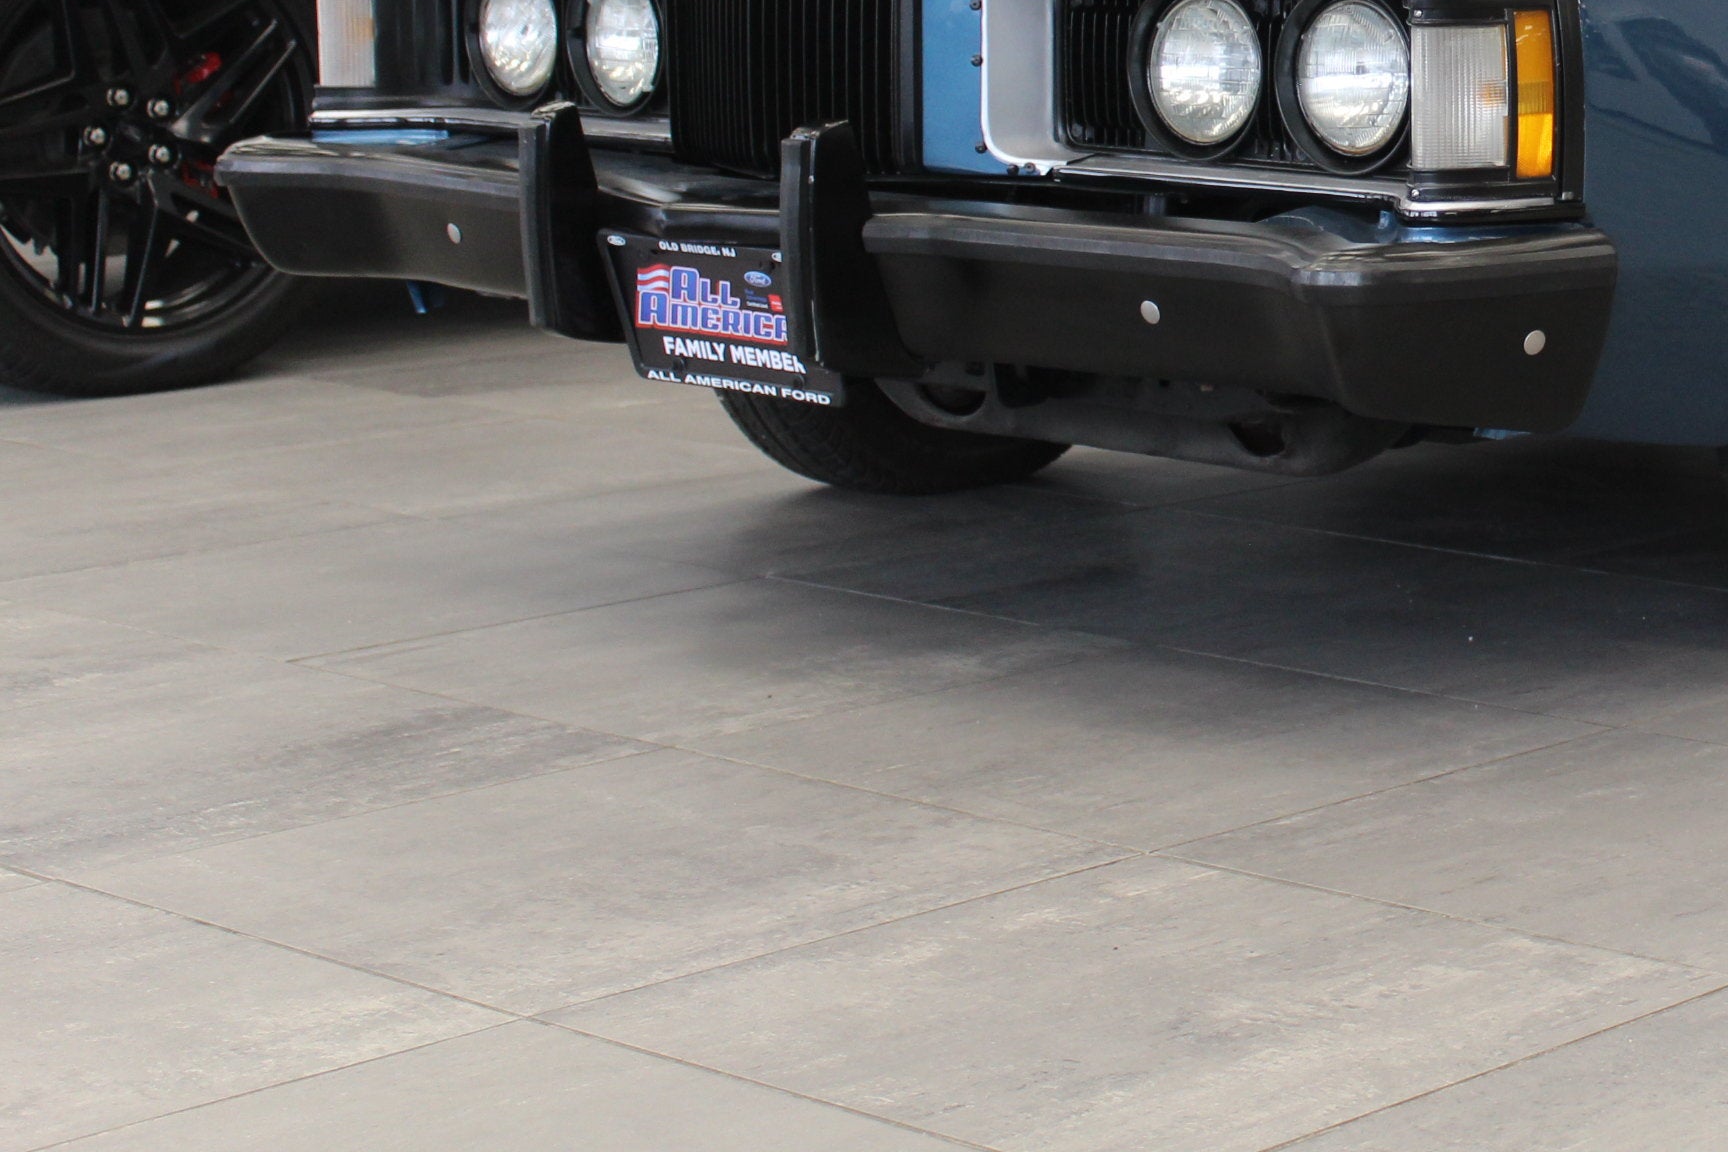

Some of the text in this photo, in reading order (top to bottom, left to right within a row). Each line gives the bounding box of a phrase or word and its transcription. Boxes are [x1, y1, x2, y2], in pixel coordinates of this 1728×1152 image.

[659, 240, 679, 252] OLD
[722, 247, 736, 258] NJ
[663, 335, 725, 362] FAMILY
[648, 370, 831, 406] ALL AMERICAN FORD
